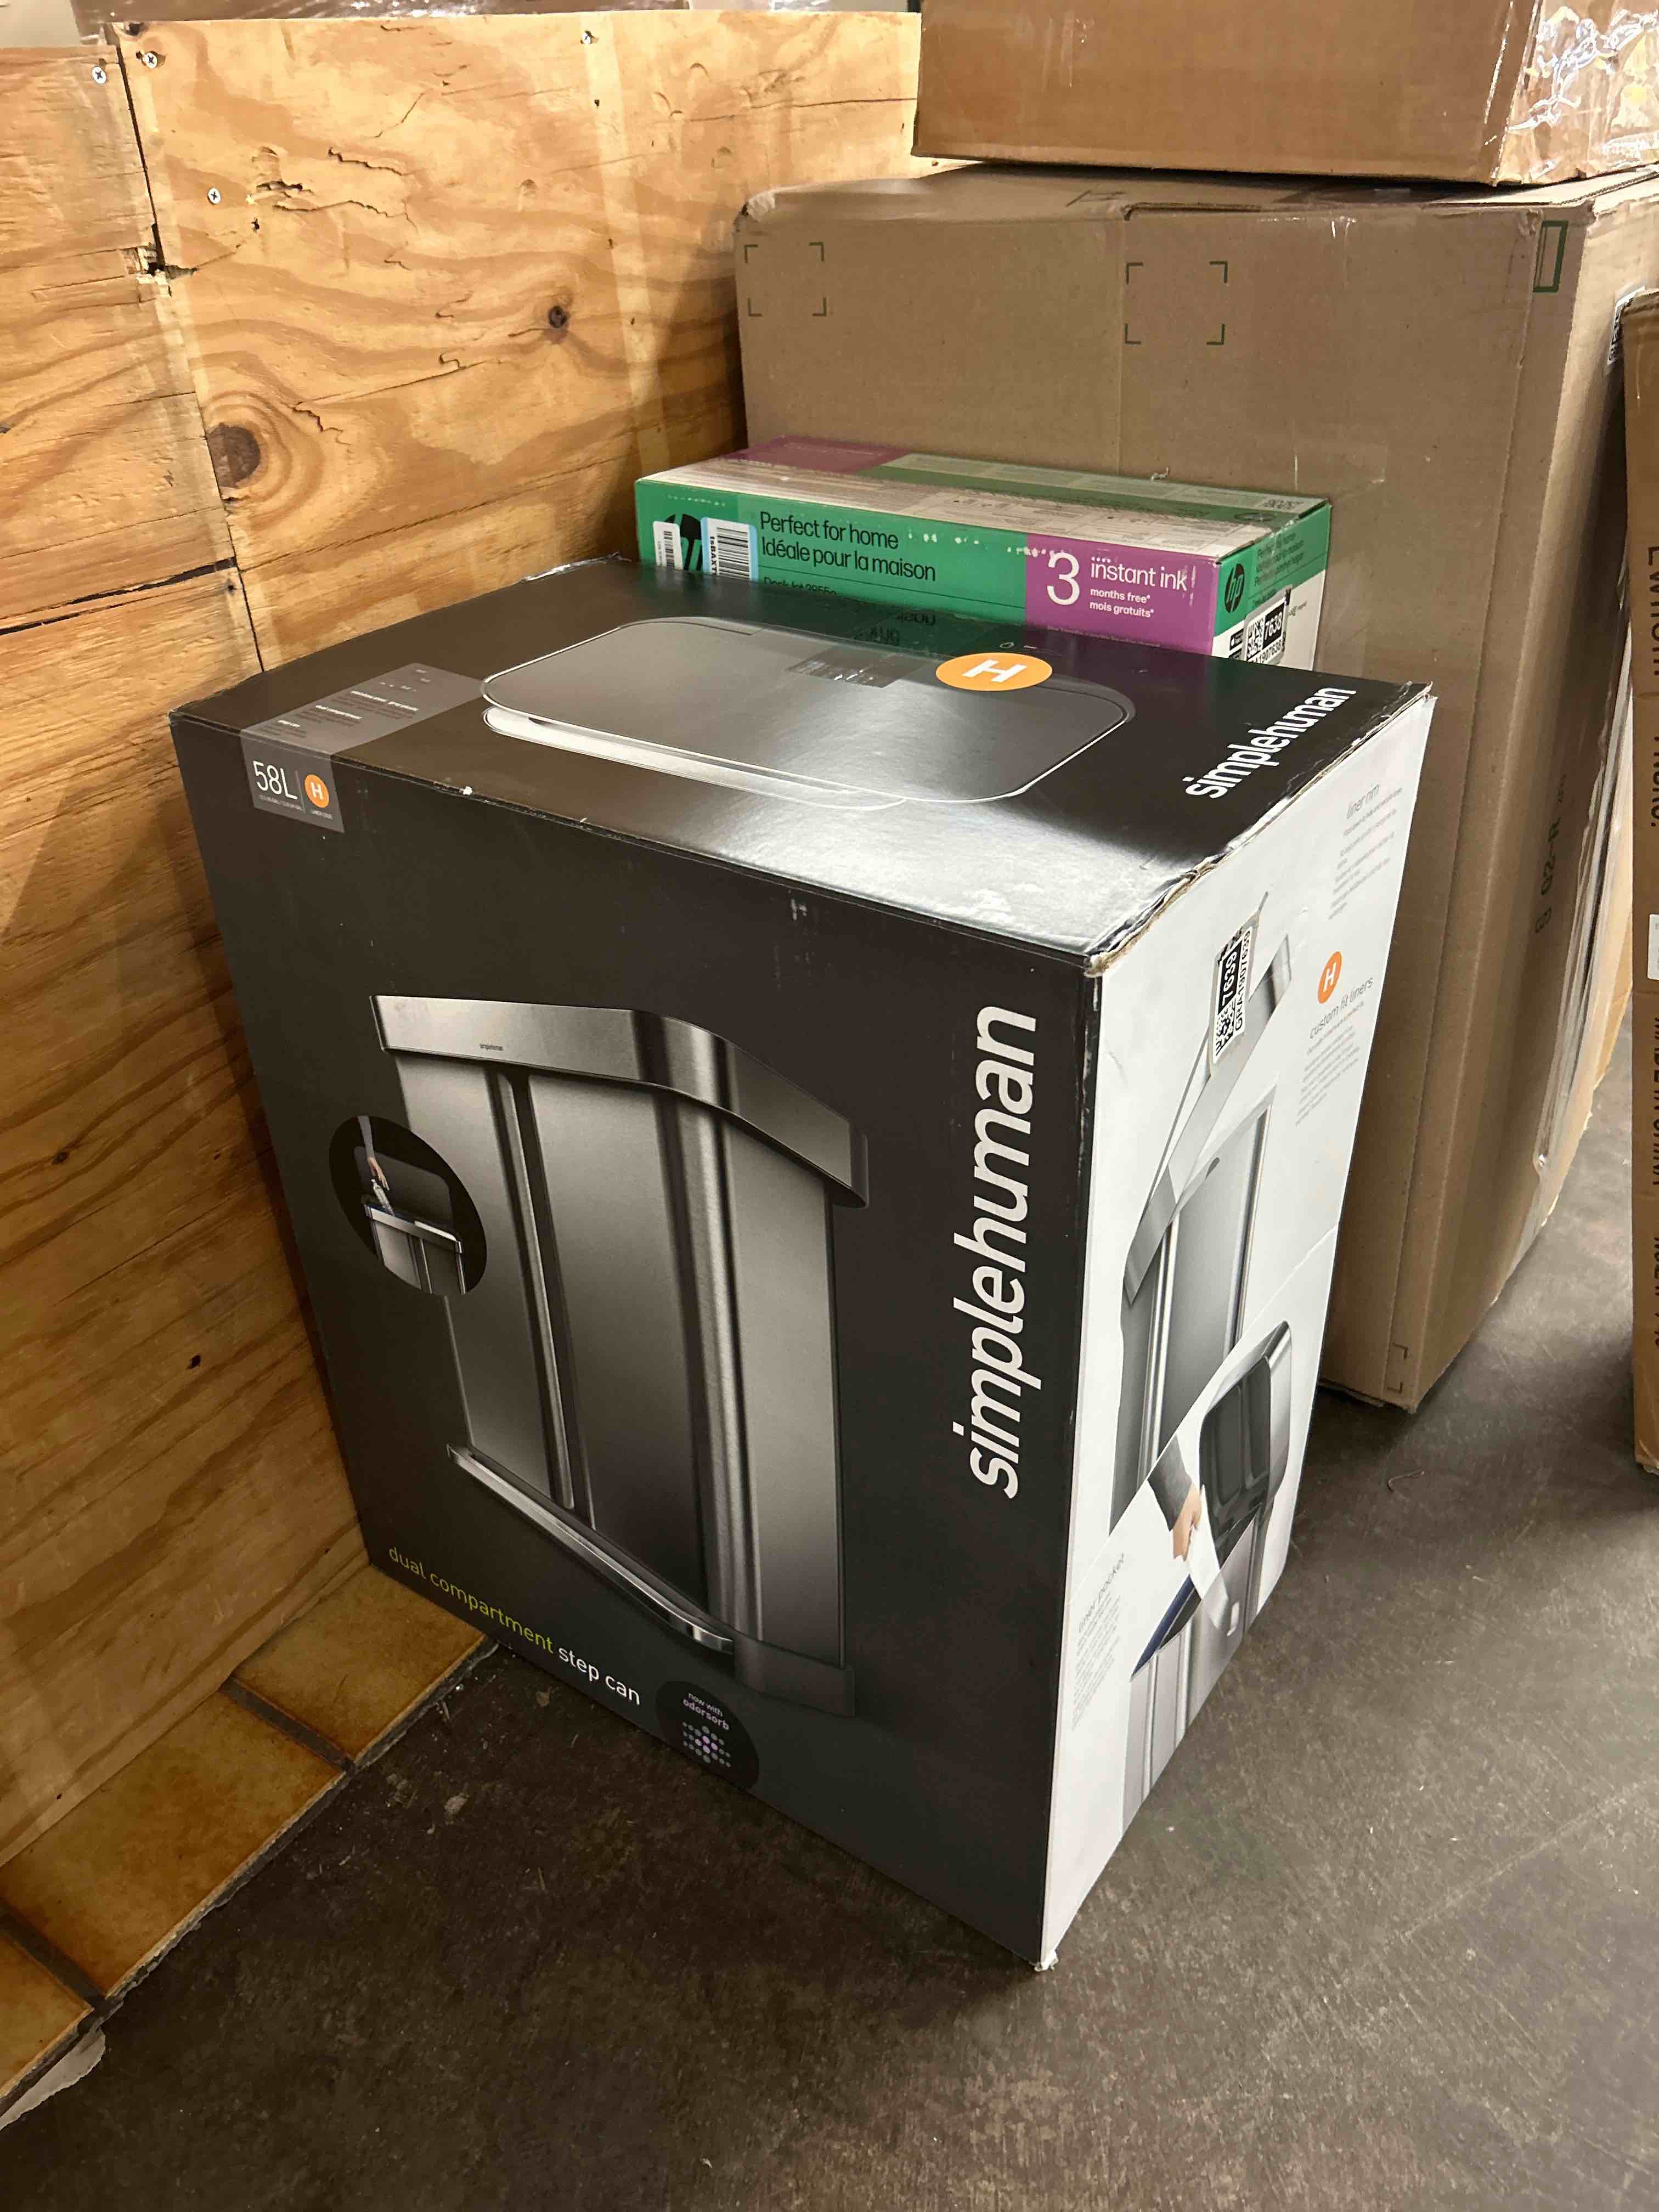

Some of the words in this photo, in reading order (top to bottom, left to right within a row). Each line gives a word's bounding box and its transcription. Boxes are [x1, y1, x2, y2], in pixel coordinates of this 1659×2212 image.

[760, 511, 820, 538] Perfect
[823, 520, 846, 541] for
[850, 524, 899, 549] home
[762, 537, 810, 561] Idéale
[813, 549, 851, 567] pour
[855, 551, 869, 571] la
[872, 557, 936, 581] maison
[1090, 556, 1156, 586] instant
[1160, 566, 1188, 591] ink
[1047, 552, 1080, 605] 3
[1090, 588, 1125, 601] months
[1090, 601, 1112, 612] mois
[1264, 612, 1283, 641] 7638
[1182, 687, 1357, 799] simplehuman
[252, 760, 298, 800] 58L
[310, 781, 325, 801] H
[1222, 951, 1237, 1007] 7639
[1323, 960, 1338, 993] H
[1310, 1005, 1339, 1039] custom
[1350, 977, 1374, 1003] liners
[952, 1005, 1042, 1500] simplehuman
[388, 1546, 426, 1579] dual
[430, 1572, 554, 1654] compartment
[558, 1646, 600, 1681] step
[605, 1674, 641, 1705] can
[682, 1699, 730, 1730] odorsorb
[688, 1692, 706, 1706] now
[706, 1702, 724, 1717] with
